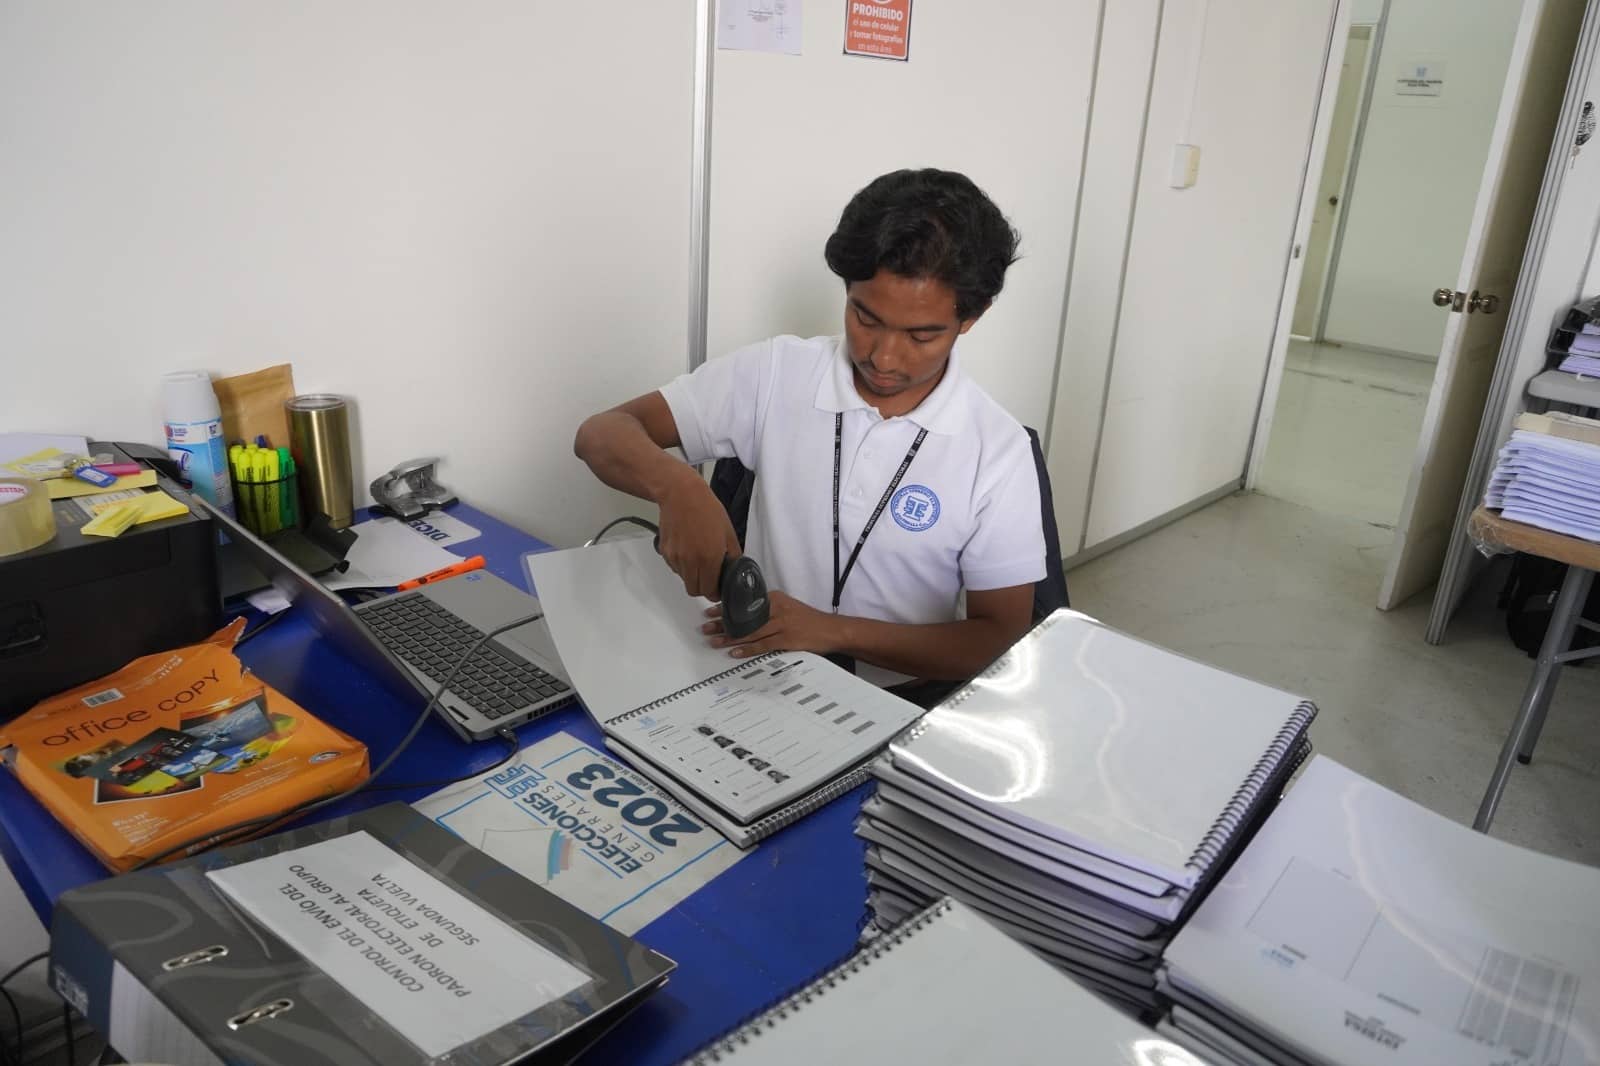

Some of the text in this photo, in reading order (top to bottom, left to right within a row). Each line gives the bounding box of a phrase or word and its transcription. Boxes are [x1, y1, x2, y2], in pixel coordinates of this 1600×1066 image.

[853, 3, 903, 21] PROHIBIDO
[522, 791, 643, 875] ELECCIONES
[547, 785, 656, 863] GENERALES
[566, 763, 704, 847] 2023
[280, 883, 424, 992] CONTROL DEL ENVÍO DEL
[289, 865, 472, 997] PADRON ELECTORAL AL GRUPO
[357, 888, 445, 948] DE ETIQUETA
[371, 873, 480, 946] SEGUNDA VUELTA
